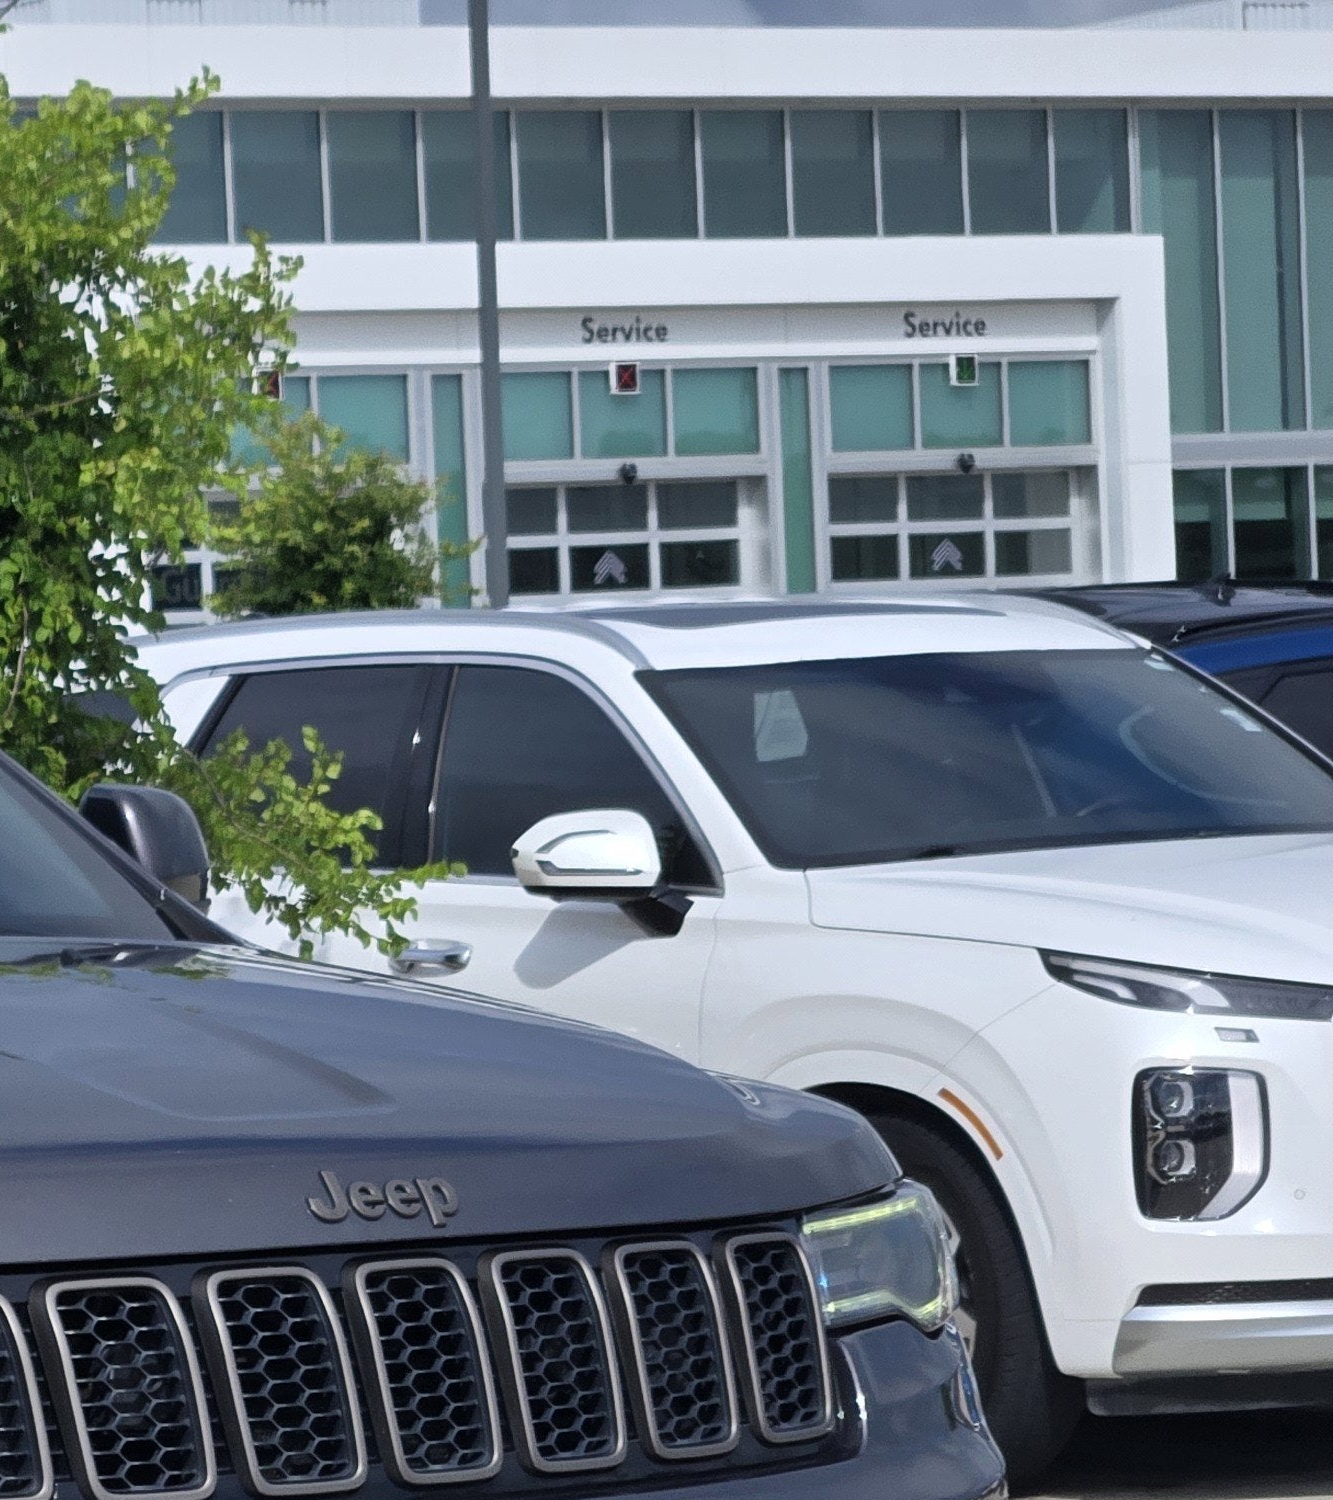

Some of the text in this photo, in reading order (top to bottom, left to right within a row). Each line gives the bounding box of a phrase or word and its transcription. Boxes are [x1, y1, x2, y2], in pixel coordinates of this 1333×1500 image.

[581, 316, 668, 343] Service
[902, 310, 987, 338] Service
[306, 1170, 459, 1228] Jeep
